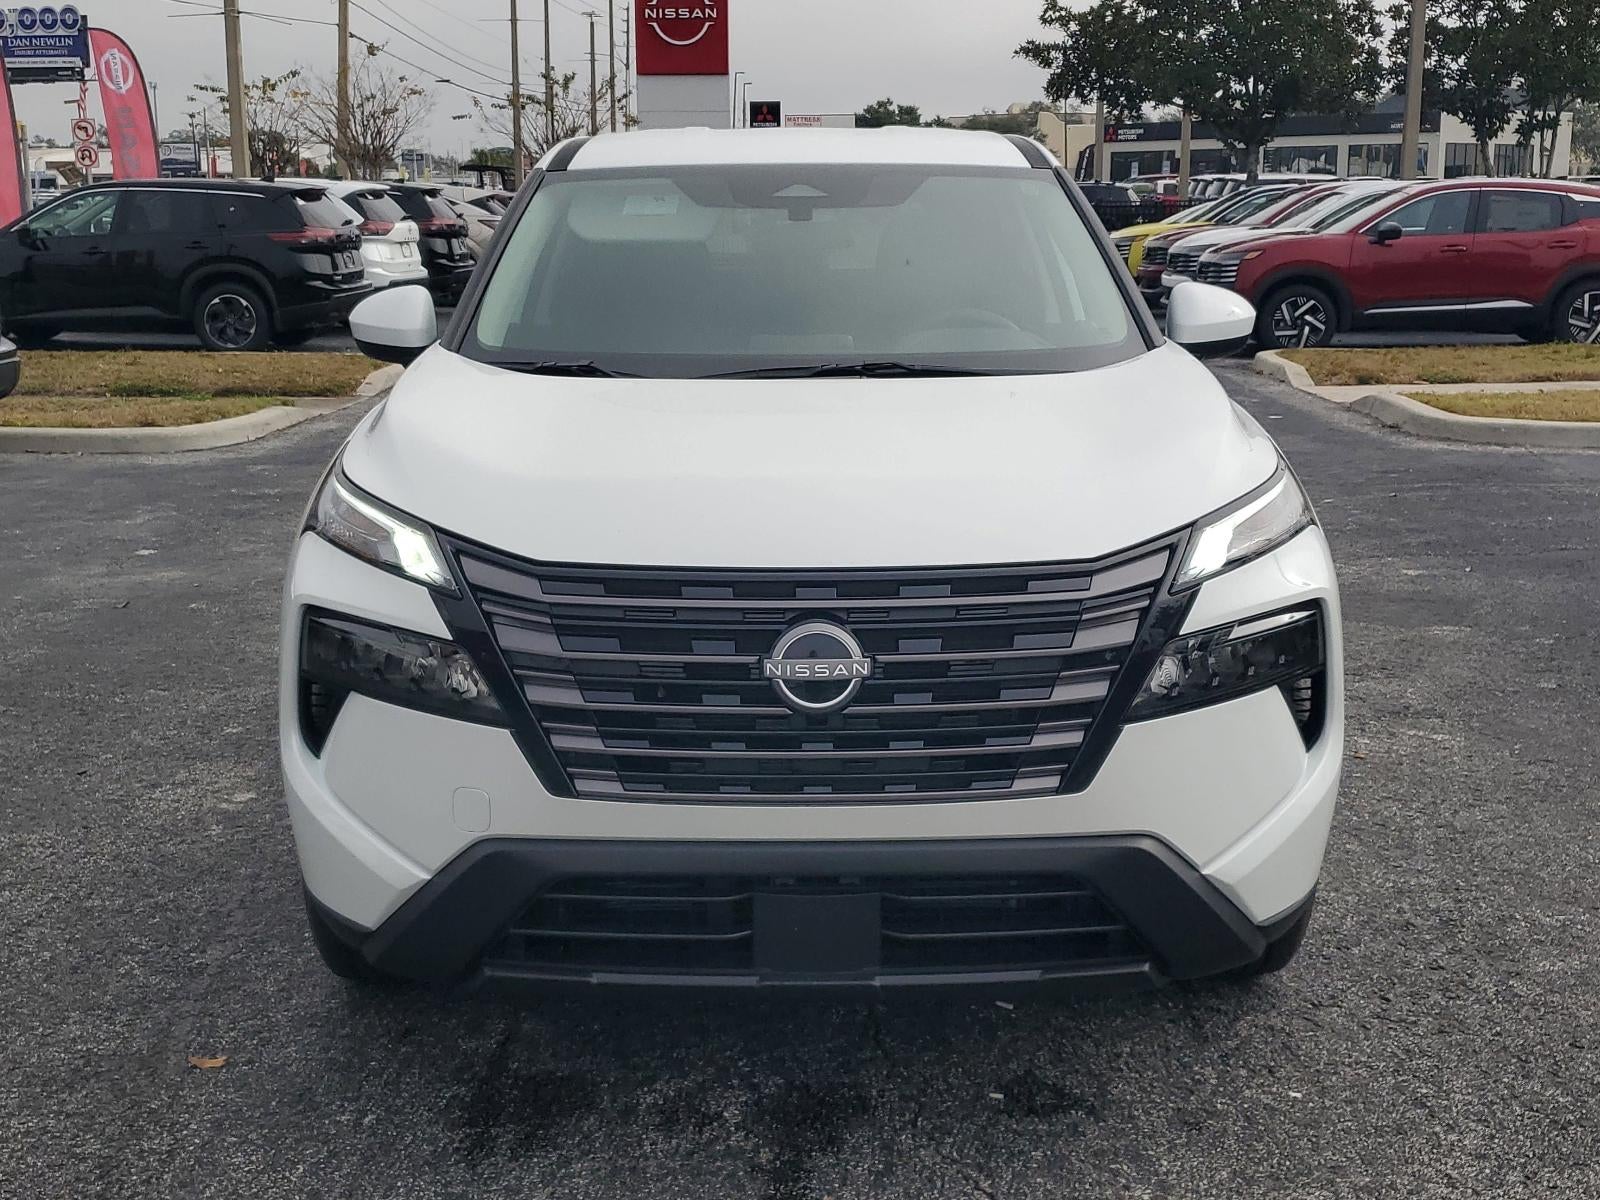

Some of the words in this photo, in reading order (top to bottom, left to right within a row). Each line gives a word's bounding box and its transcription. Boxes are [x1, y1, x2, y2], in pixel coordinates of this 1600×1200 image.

[644, 8, 717, 18] NISSAN
[8, 37, 30, 46] DAN
[32, 37, 73, 46] NEWLIN
[766, 663, 868, 677] NISSAN
